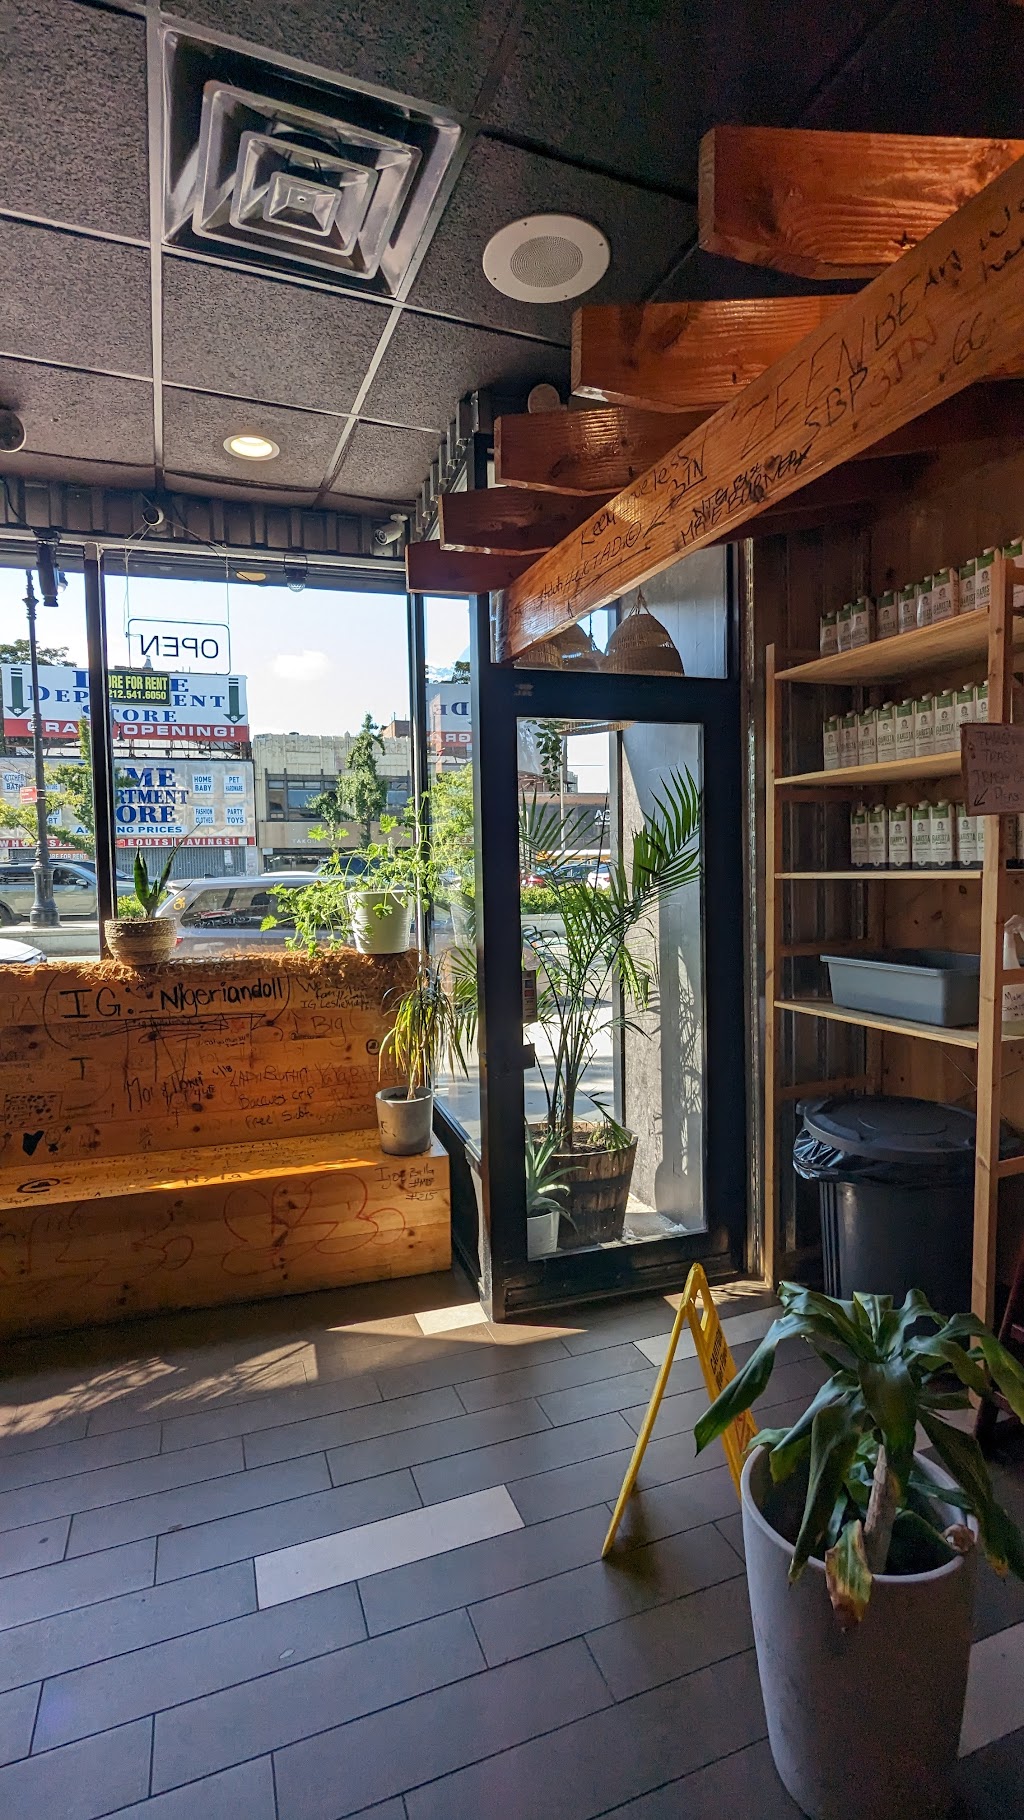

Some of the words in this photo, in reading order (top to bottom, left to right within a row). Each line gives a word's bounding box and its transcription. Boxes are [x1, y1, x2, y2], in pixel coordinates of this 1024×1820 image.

[107, 675, 123, 689] ORE
[125, 675, 142, 689] FOR
[145, 677, 168, 691] RENT
[123, 724, 235, 737] OPENING!
[116, 805, 177, 823] ORE
